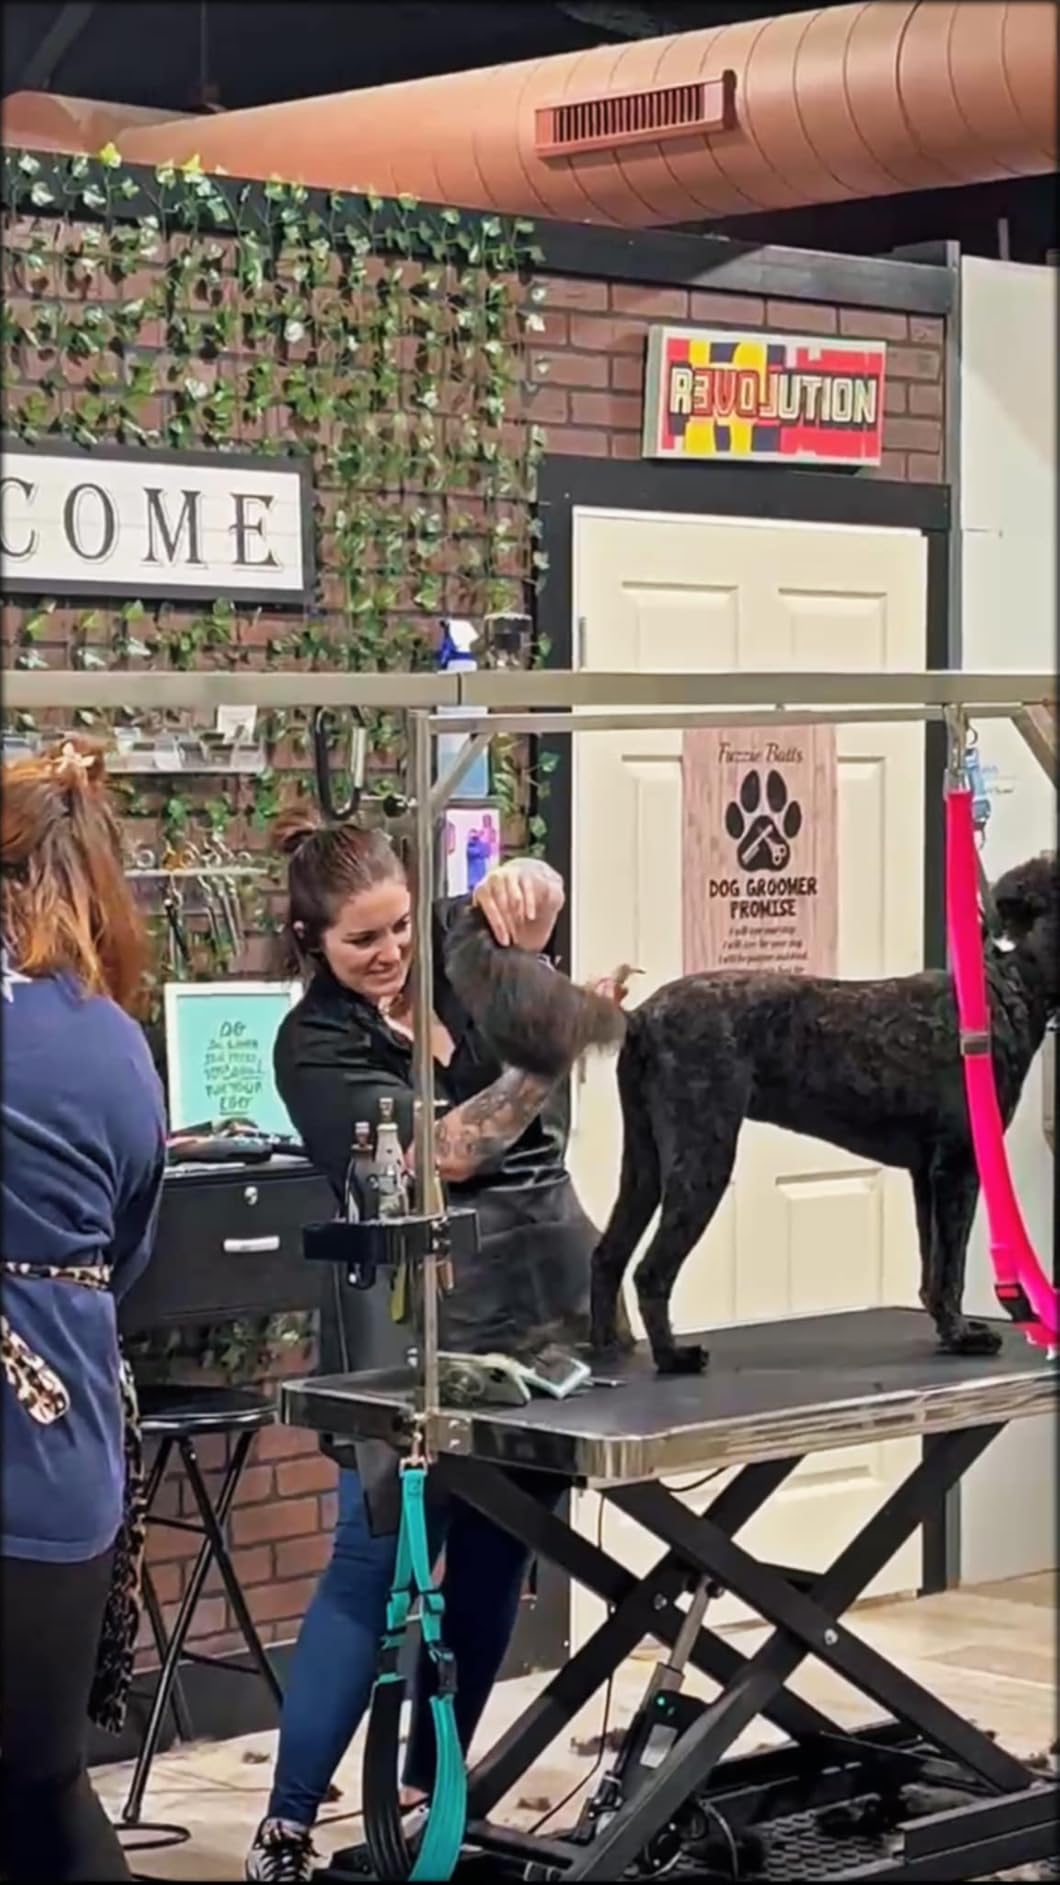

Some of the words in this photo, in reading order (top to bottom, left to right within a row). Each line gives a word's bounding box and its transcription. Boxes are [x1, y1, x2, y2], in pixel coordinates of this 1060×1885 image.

[669, 365, 879, 425] REVOLUTION
[718, 742, 761, 763] Fuzzie
[765, 742, 803, 763] Butts
[709, 878, 740, 897] DOG
[746, 876, 817, 897] GROOMER
[730, 899, 796, 919] PROMISE
